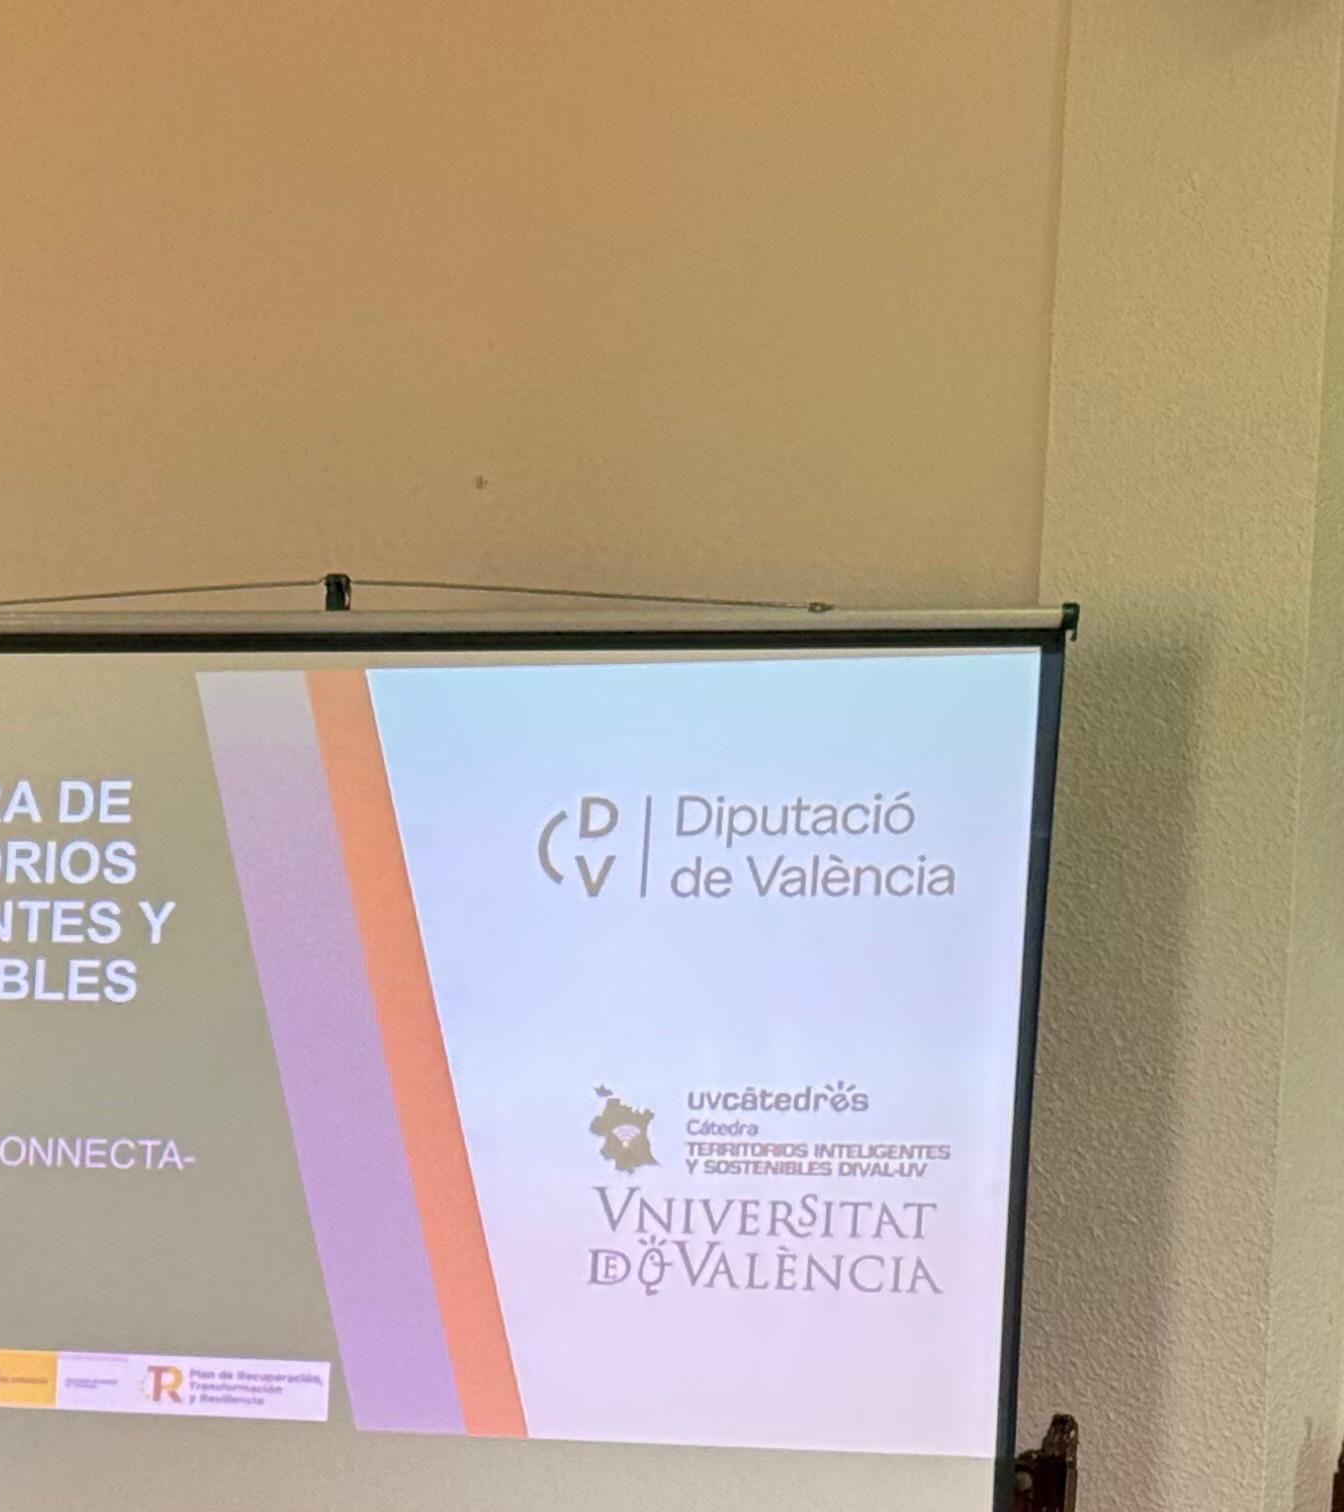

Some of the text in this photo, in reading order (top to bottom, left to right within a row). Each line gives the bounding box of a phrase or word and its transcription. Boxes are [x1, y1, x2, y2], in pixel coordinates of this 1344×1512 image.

[58, 780, 133, 823] DE
[675, 791, 917, 848] Diputació
[670, 853, 956, 898] de València
[138, 901, 177, 944] Y
[686, 1119, 759, 1137] Cátedra
[685, 1141, 952, 1161] TERRITORIOS INTELIGENTES
[686, 1160, 699, 1175] Y
[703, 1160, 833, 1177] SOSTENIBLES
[592, 1185, 938, 1240] VNIVERSITAT
[670, 1239, 945, 1295] VALÈNCIA
